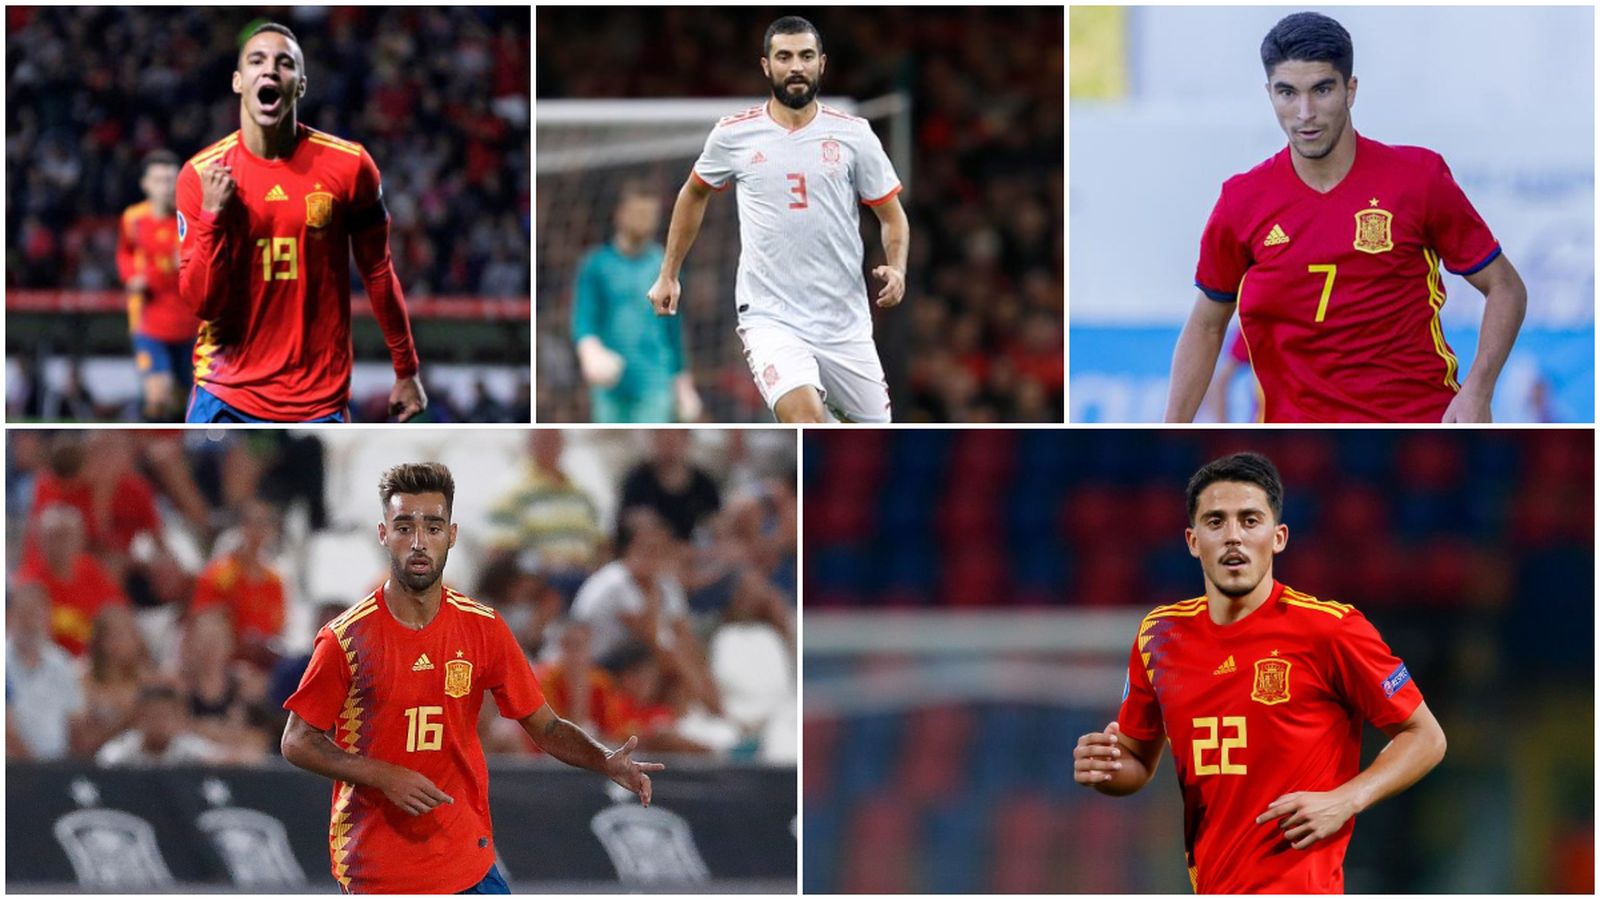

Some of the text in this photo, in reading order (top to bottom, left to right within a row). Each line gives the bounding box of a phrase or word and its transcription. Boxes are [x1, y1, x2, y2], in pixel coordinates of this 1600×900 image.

[786, 173, 808, 209] 3
[256, 237, 298, 281] 19
[1308, 264, 1337, 322] 7
[404, 706, 444, 752] 16
[1192, 716, 1247, 776] 22
